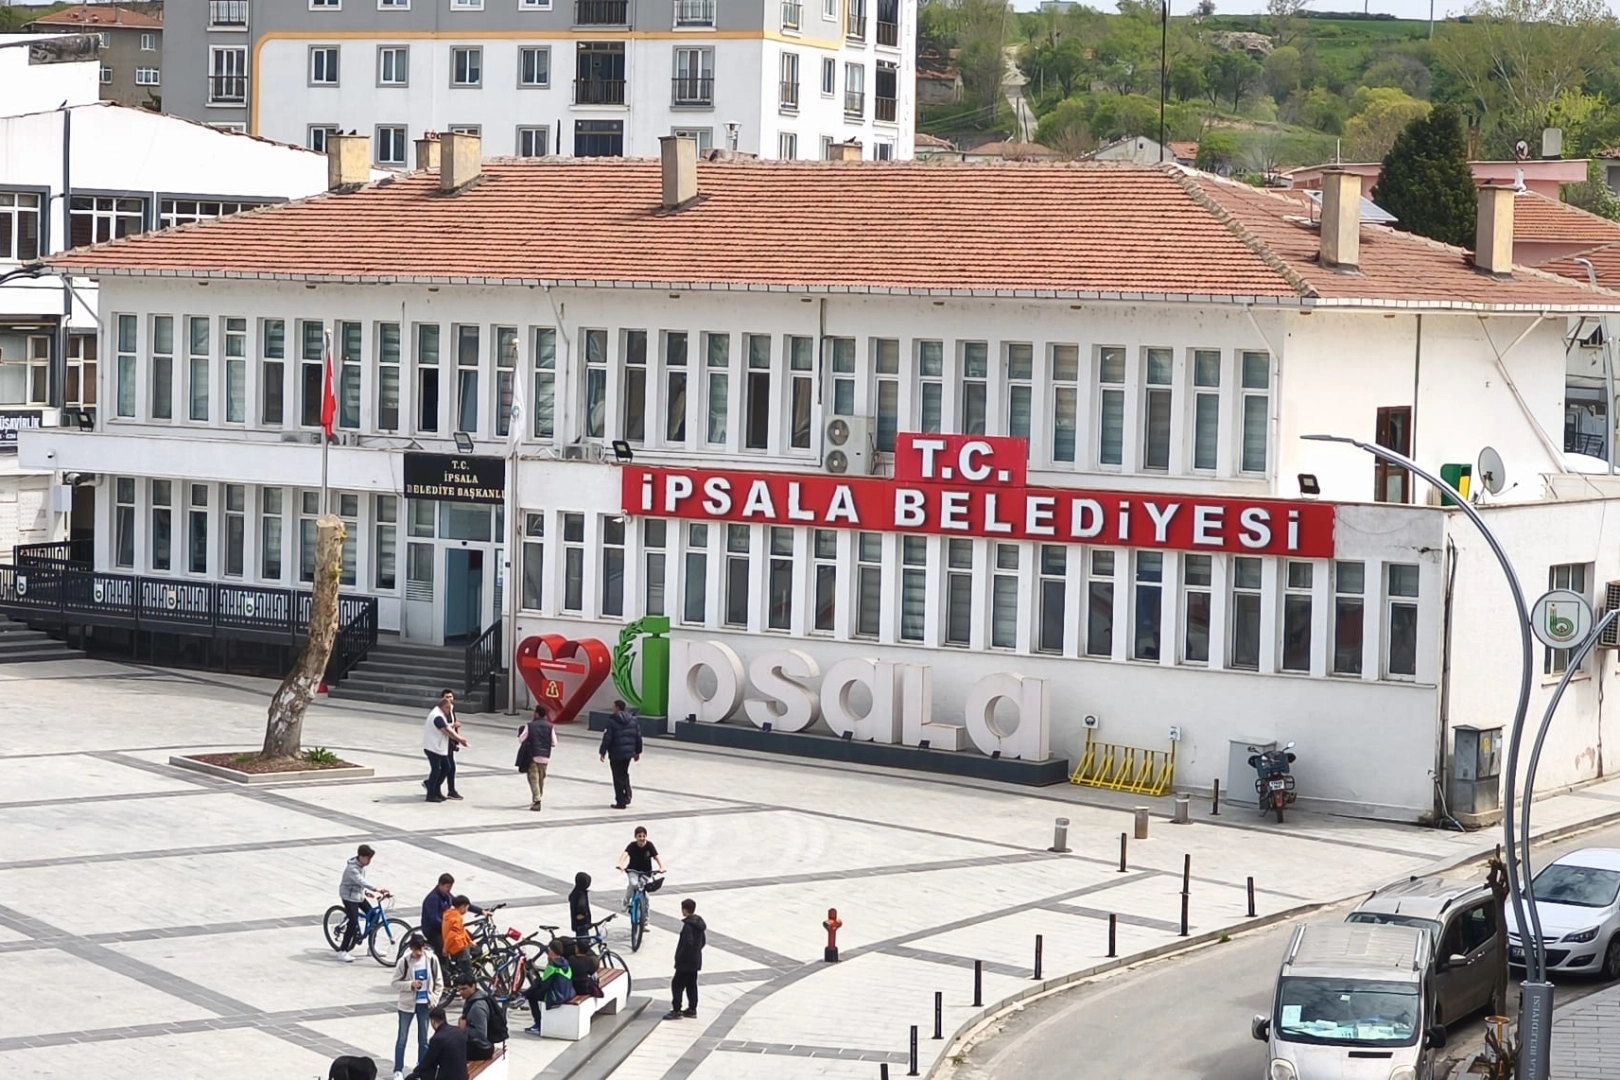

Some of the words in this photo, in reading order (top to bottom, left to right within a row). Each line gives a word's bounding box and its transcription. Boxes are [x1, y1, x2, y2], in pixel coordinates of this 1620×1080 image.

[451, 460, 470, 470] T.C.
[912, 439, 1011, 482] T.C.
[444, 471, 479, 484] İPSALA
[406, 484, 455, 496] BELEDİYE
